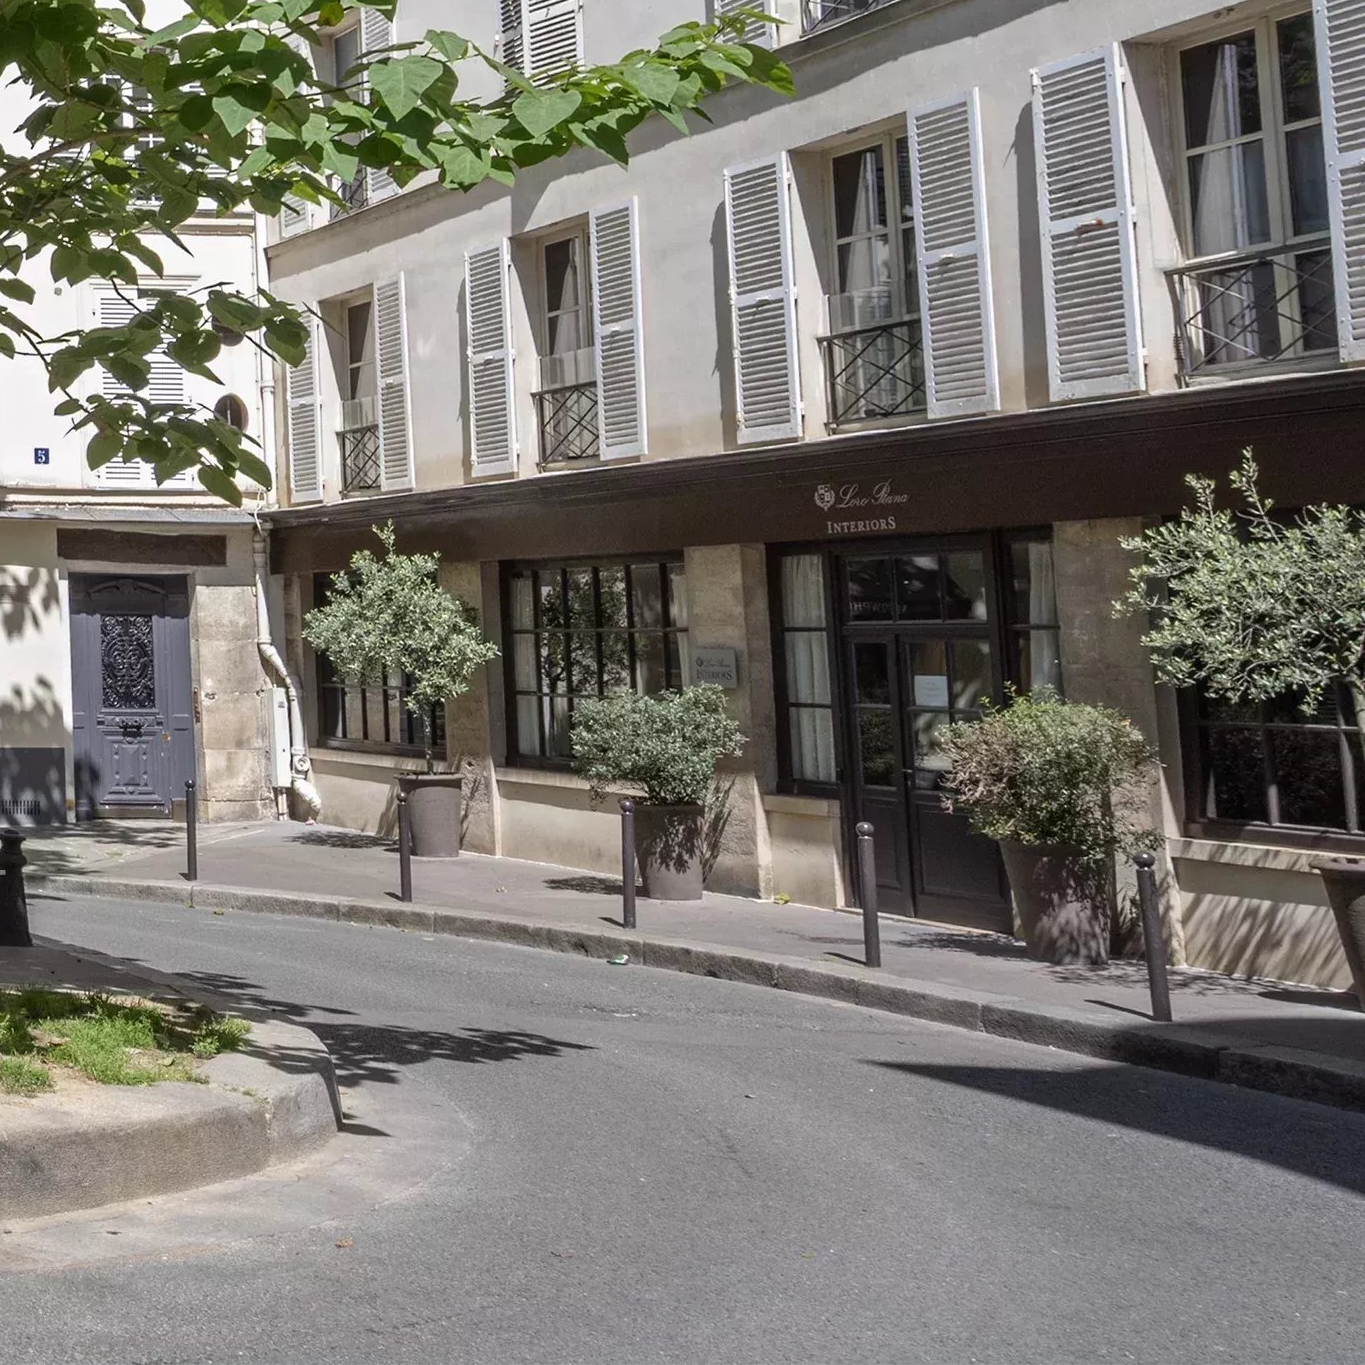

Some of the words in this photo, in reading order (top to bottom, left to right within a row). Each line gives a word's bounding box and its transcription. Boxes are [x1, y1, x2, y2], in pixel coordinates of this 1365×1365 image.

[37, 450, 46, 463] 5
[835, 483, 869, 509] Loro
[871, 477, 910, 505] Piana
[826, 515, 897, 534] INTERIORS
